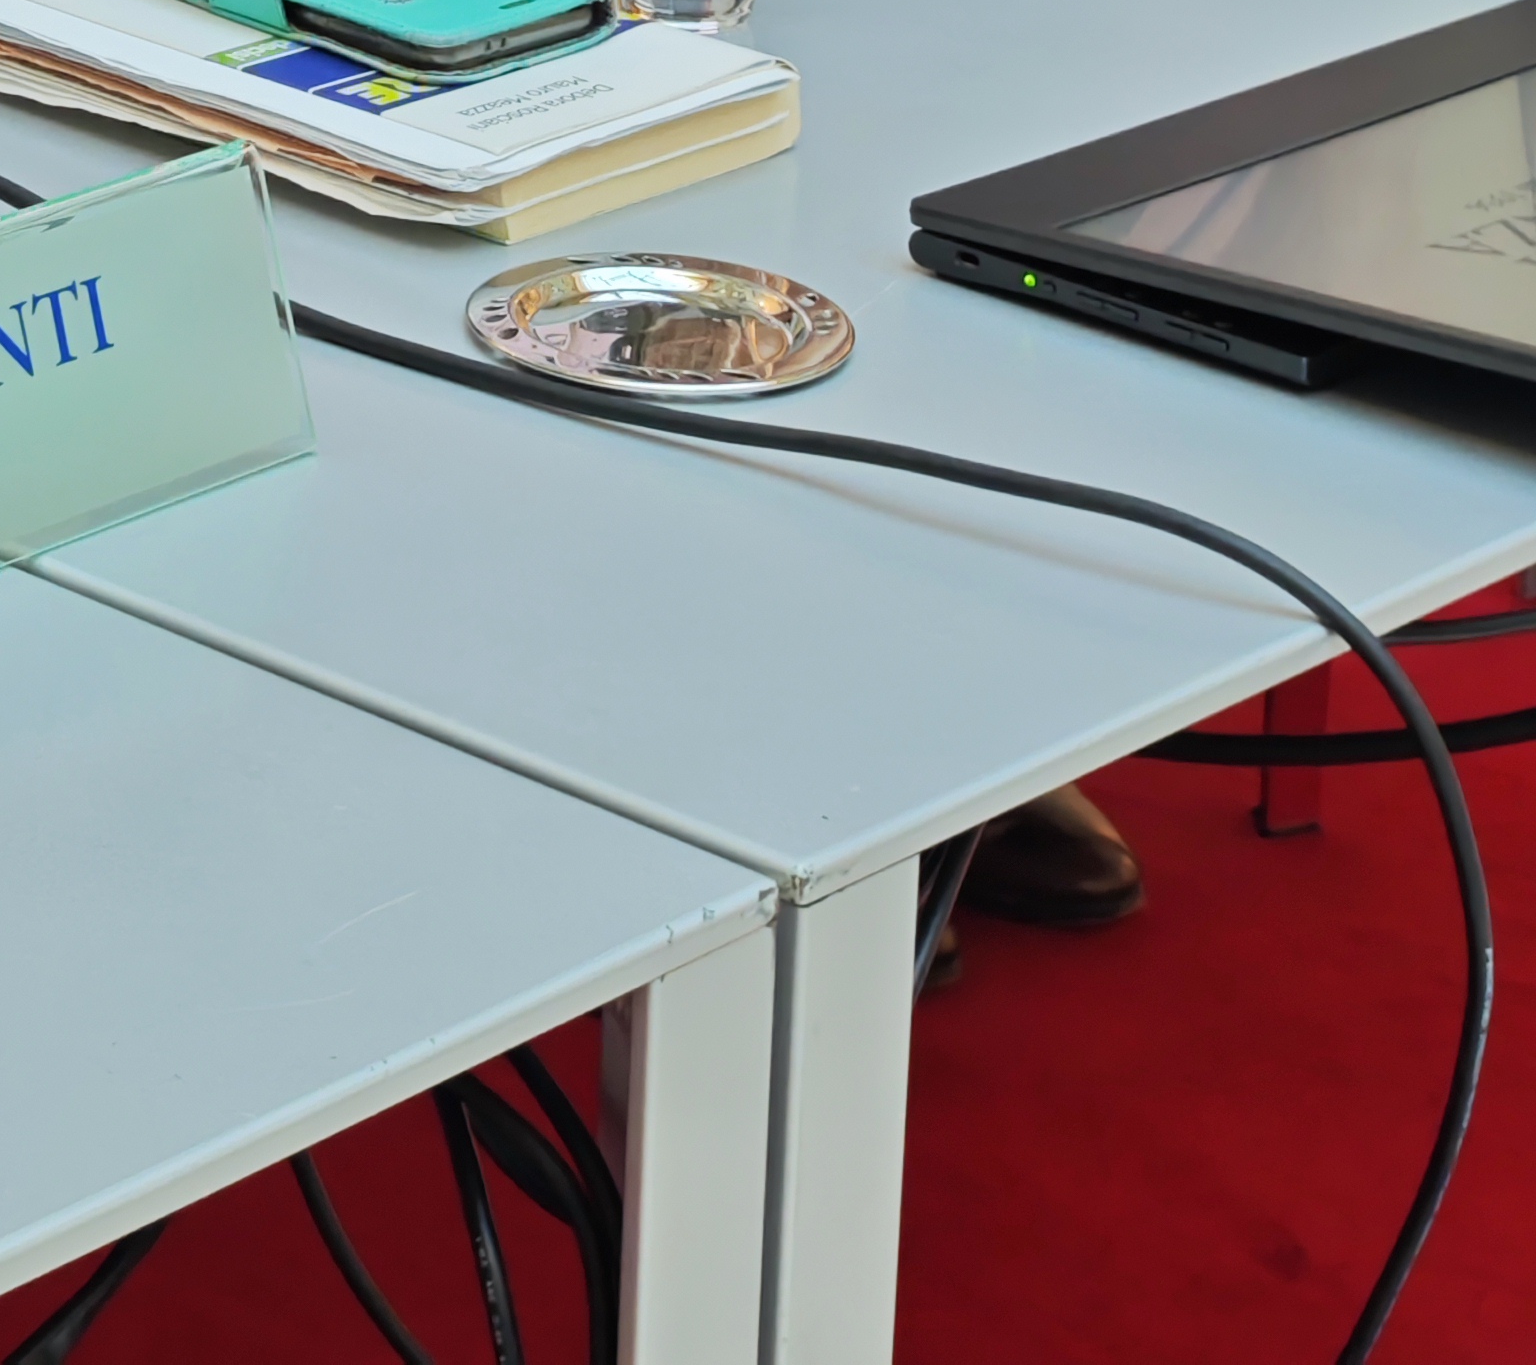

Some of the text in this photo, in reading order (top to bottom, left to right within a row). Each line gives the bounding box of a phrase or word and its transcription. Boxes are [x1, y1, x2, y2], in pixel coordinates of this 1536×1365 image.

[457, 75, 589, 117] Mauro Meazza
[543, 83, 614, 107] Debora
